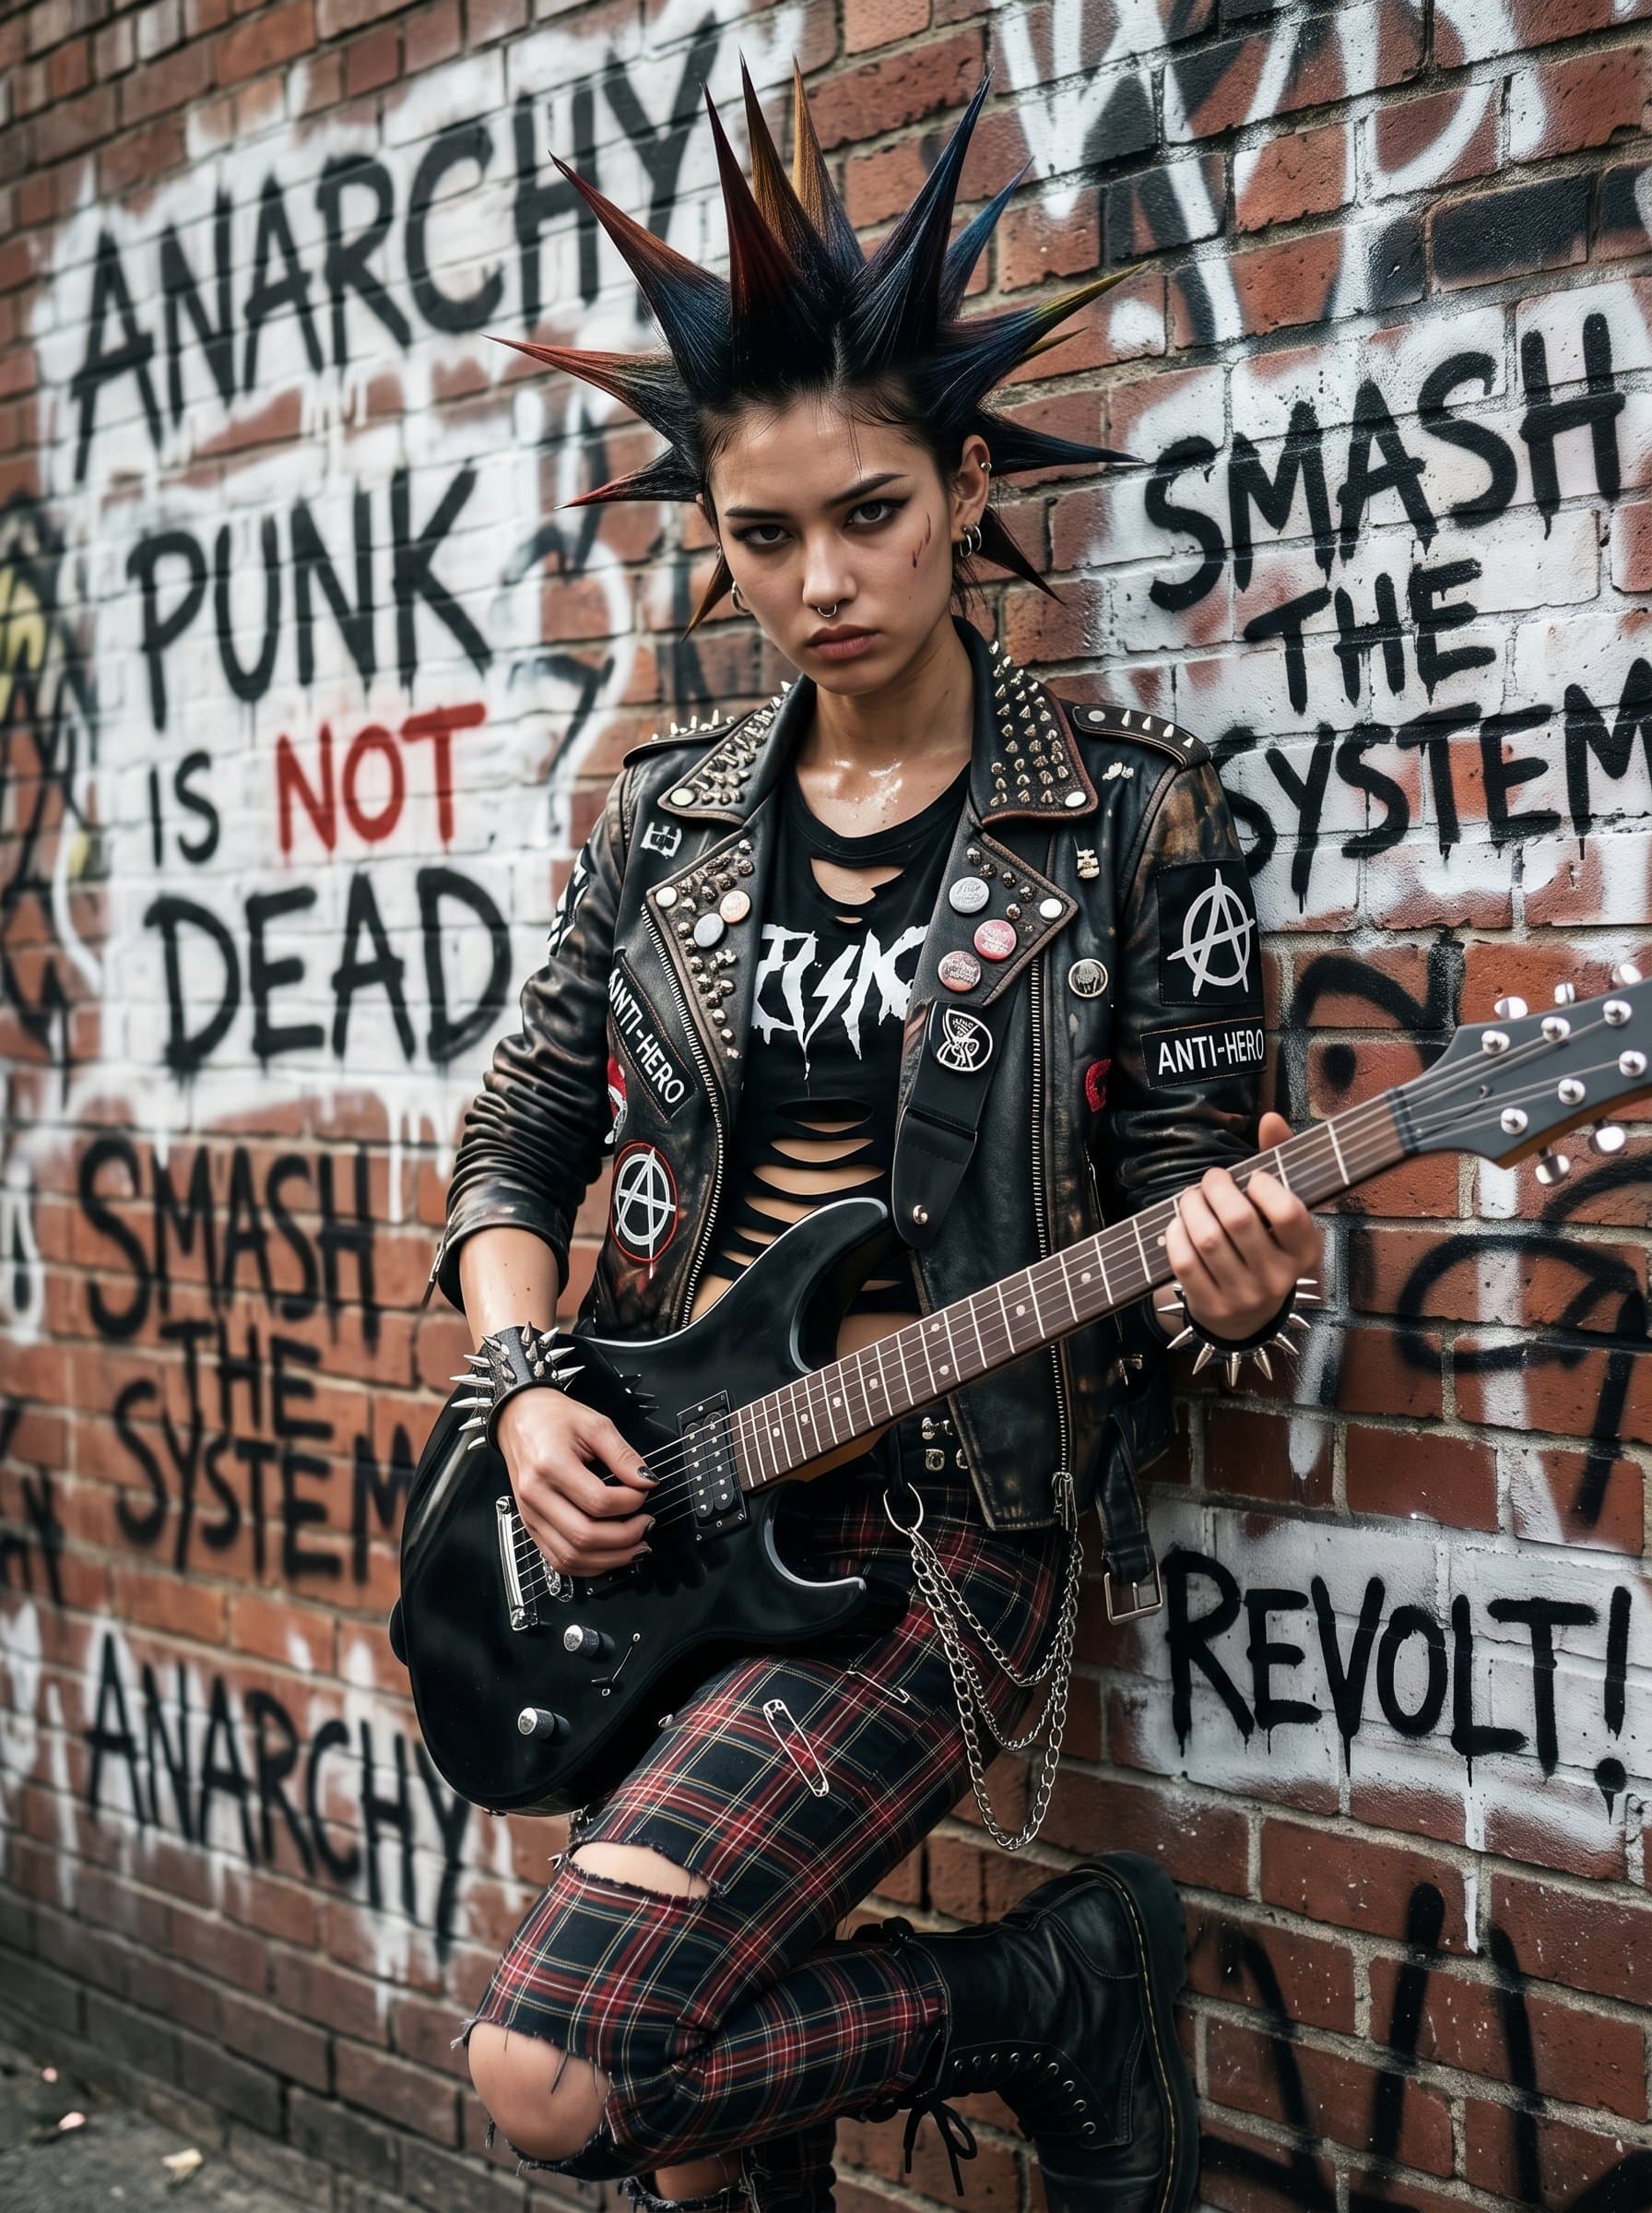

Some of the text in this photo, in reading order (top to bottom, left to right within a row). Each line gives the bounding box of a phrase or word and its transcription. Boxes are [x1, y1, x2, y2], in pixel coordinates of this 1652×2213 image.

[71, 10, 720, 483] ANARCHY
[1145, 312, 1625, 612] SMASH
[126, 458, 493, 732] PUNK
[1245, 557, 1496, 715] THE
[150, 701, 487, 869] IS NOT
[1210, 657, 1652, 894] SYSTEM
[145, 865, 513, 1079] DEAD
[608, 968, 685, 1104] ANTI-HERO
[1158, 1028, 1264, 1075] ANTI-HERO
[79, 1134, 379, 1352] SMASH
[114, 1378, 417, 1584] SYSTEM
[160, 1317, 333, 1440] THE
[1163, 1547, 1632, 1812] REVOLT!
[86, 1628, 468, 1959] ANARCHY
